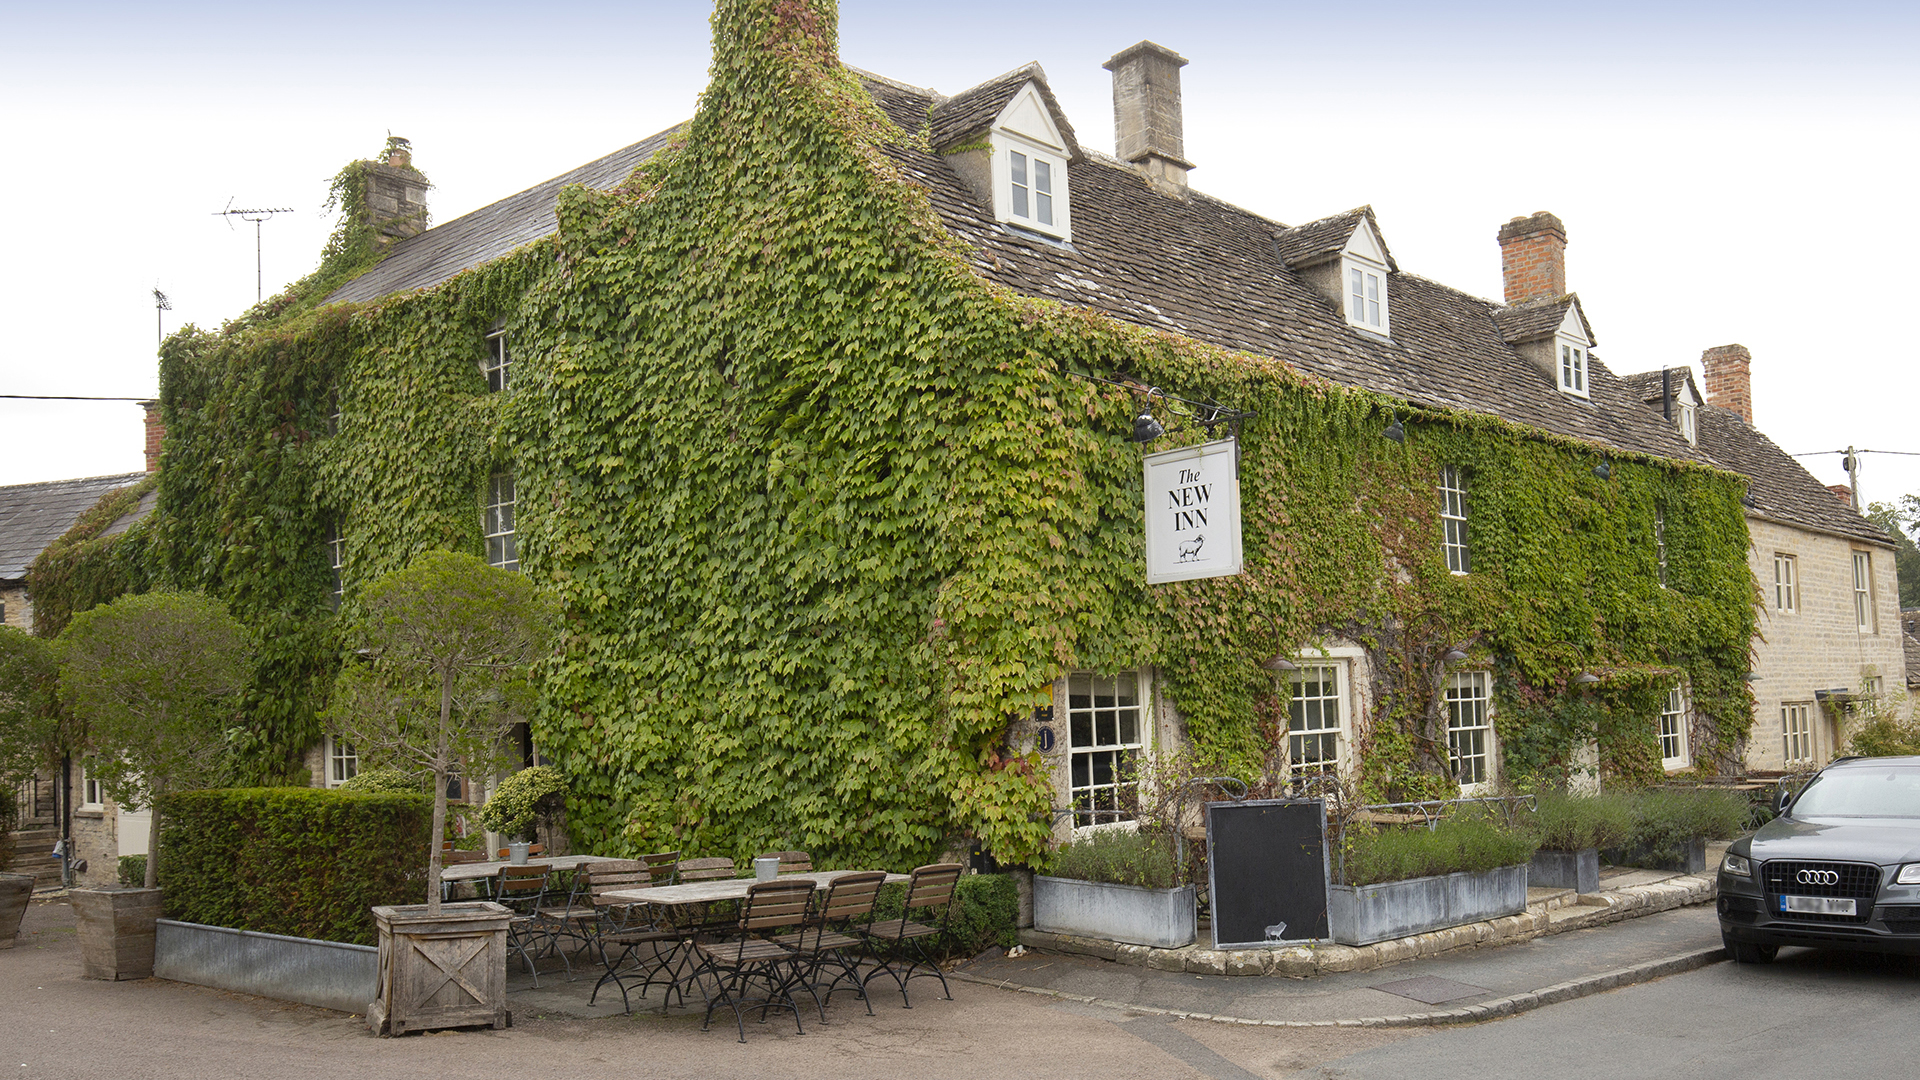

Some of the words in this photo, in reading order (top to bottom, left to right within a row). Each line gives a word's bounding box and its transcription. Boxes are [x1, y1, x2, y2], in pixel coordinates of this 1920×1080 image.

[1179, 468, 1200, 484] The
[1168, 483, 1212, 509] NEW
[1175, 507, 1207, 531] INN
